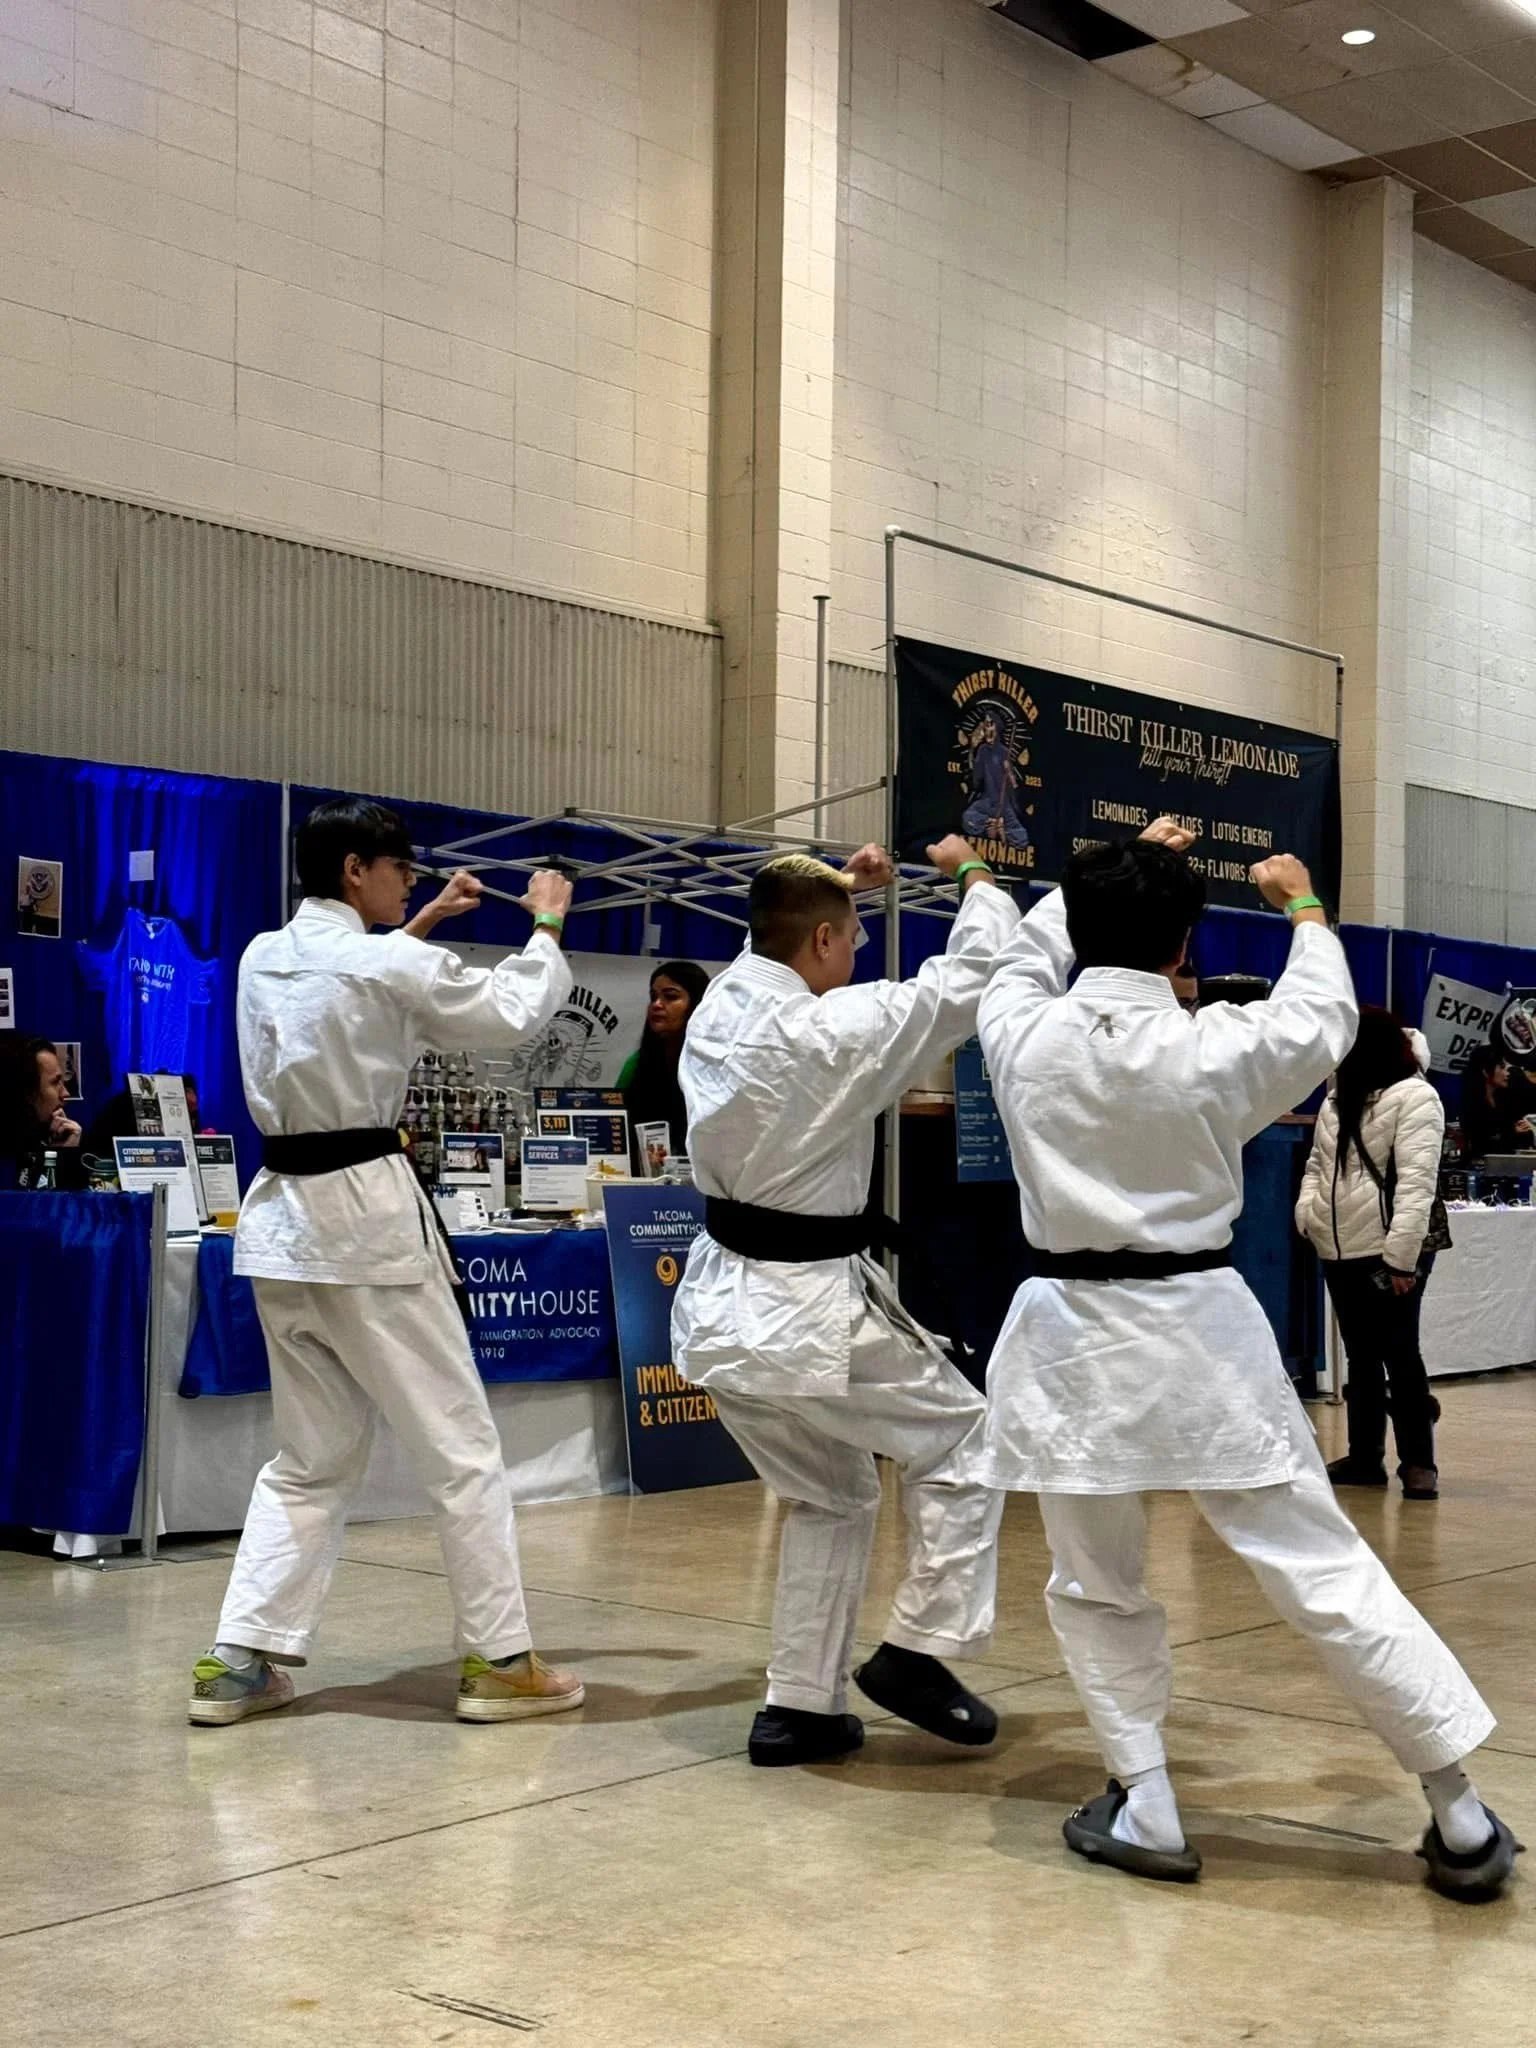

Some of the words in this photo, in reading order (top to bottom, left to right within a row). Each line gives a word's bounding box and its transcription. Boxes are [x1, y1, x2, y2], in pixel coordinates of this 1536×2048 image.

[952, 670, 994, 708] THIRST
[998, 671, 1039, 724] KILLER
[1063, 703, 1133, 744] THIRST
[1140, 720, 1203, 759] KILLER
[1211, 735, 1300, 779] LEMONADE
[1092, 799, 1148, 828] LEMONADES
[1211, 821, 1240, 844] LOTUS
[1242, 826, 1273, 849] ENERGY
[962, 836, 1035, 869] EMONADE
[1207, 858, 1246, 882] FLAVORS
[568, 985, 619, 1035] KILLER
[528, 1151, 560, 1160] SERVICES
[653, 1210, 694, 1222] TACOMA
[549, 1326, 601, 1340] ADVOCACY
[480, 1347, 505, 1360] 1910
[639, 1400, 654, 1427] &
